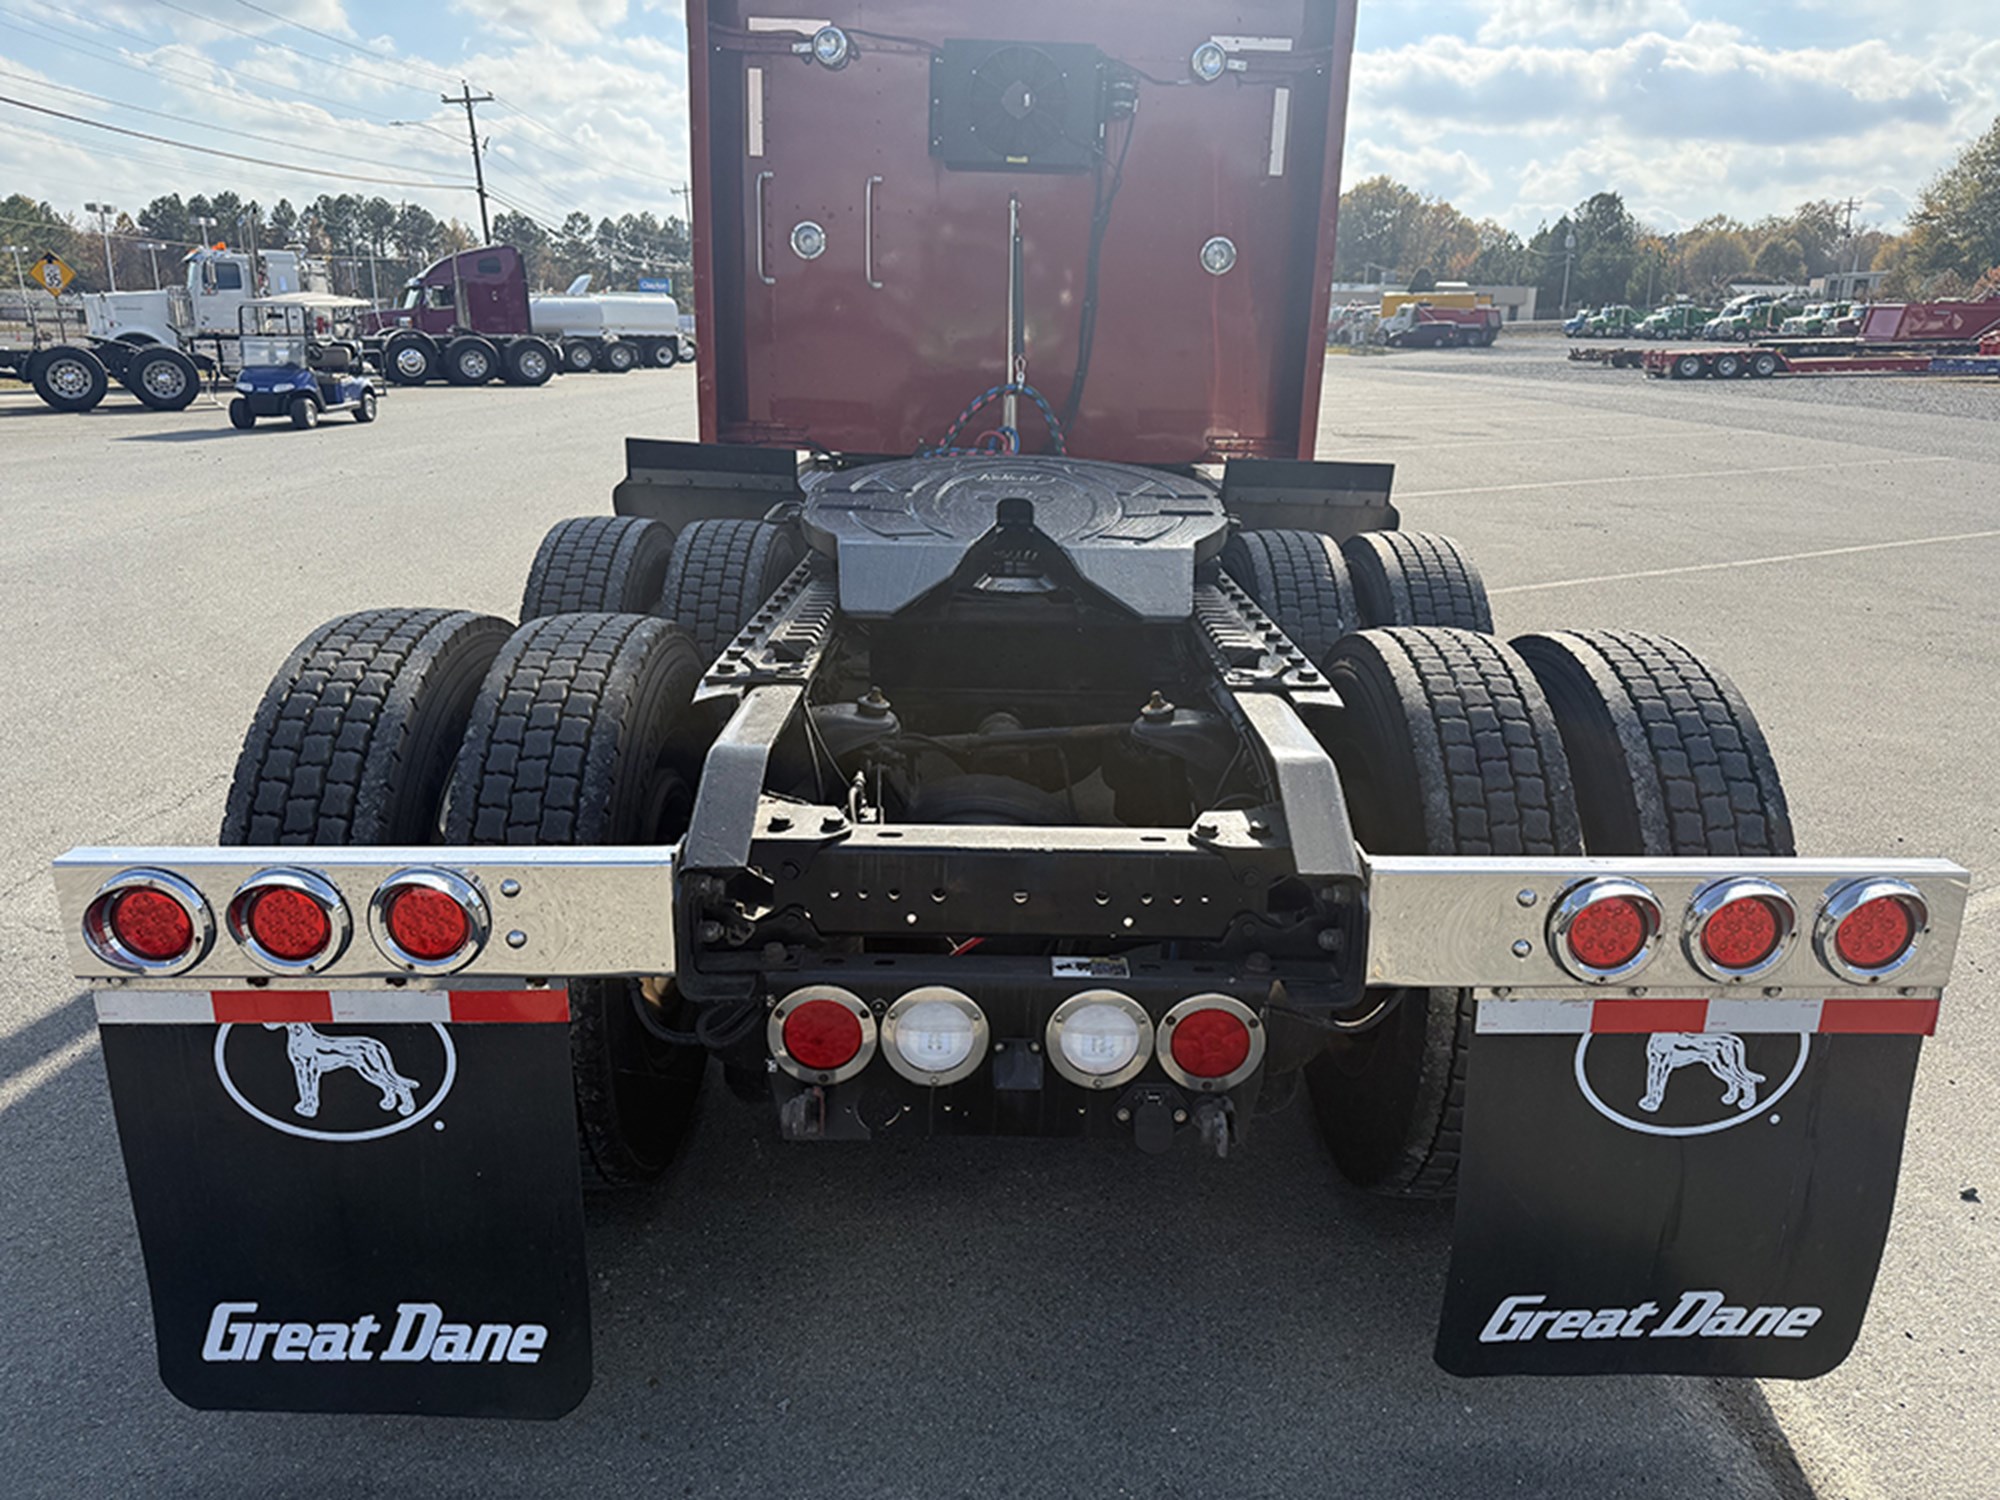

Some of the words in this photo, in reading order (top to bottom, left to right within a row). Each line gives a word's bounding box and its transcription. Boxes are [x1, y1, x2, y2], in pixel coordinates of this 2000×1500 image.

[46, 272, 62, 288] 35
[202, 1302, 381, 1362] Great
[379, 1302, 548, 1363] Dane
[1479, 1295, 1660, 1343] Great
[1650, 1290, 1823, 1338] Dane
